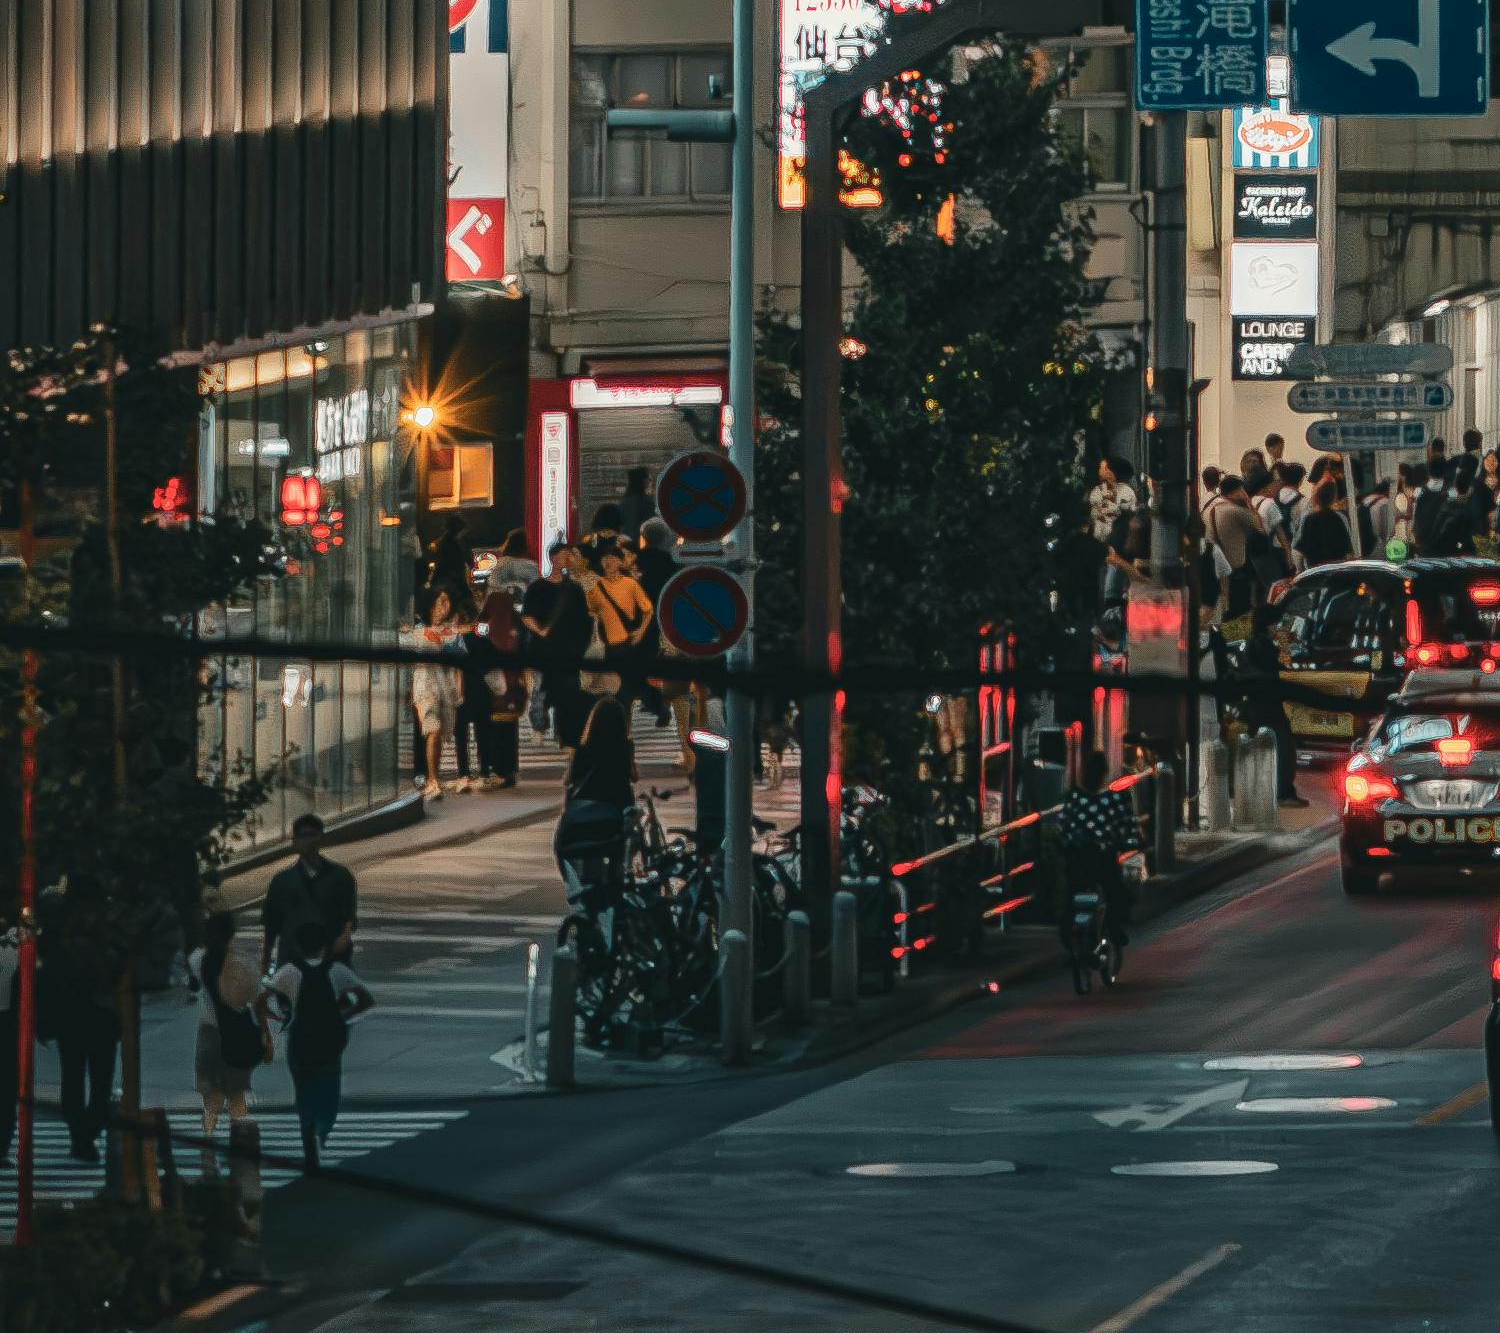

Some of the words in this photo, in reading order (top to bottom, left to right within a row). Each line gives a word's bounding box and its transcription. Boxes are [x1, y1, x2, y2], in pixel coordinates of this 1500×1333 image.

[1238, 196, 1314, 219] Kaleido
[1240, 321, 1306, 339] LOUNGE
[1240, 359, 1283, 376] AND.
